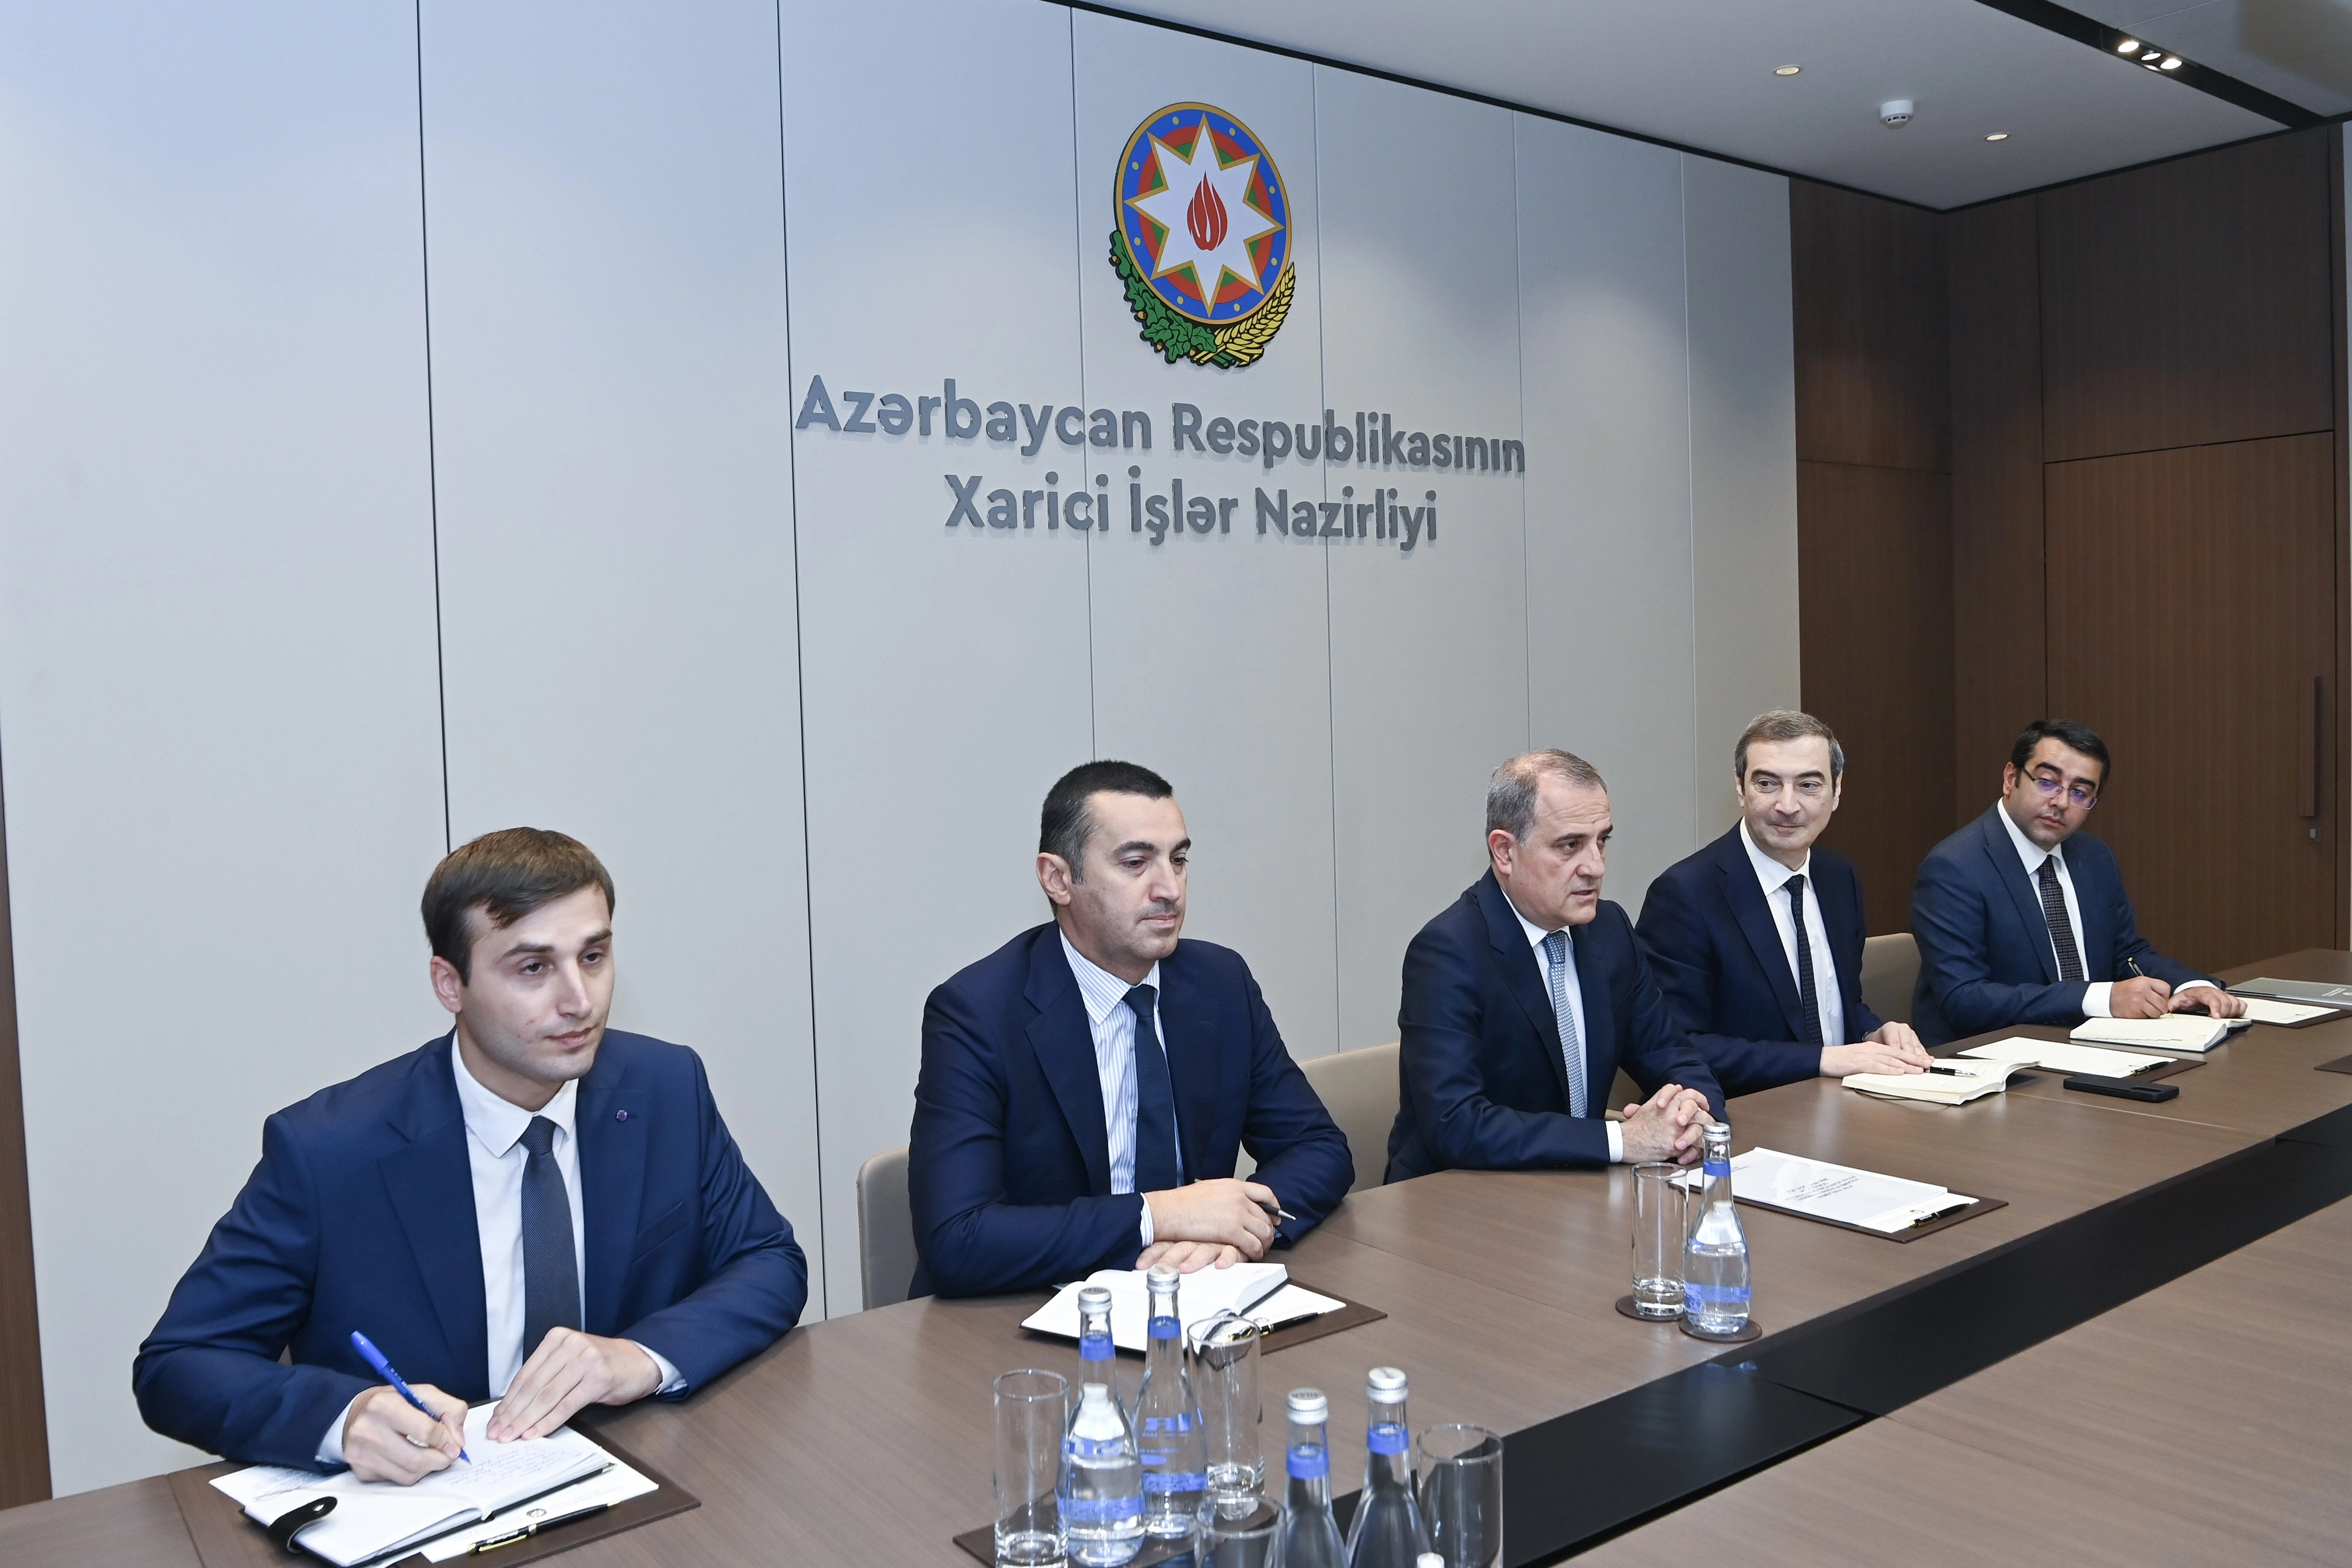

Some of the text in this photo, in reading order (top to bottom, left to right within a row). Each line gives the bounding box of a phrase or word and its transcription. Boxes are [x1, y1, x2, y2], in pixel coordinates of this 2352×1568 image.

[795, 375, 1525, 472] Azərbaycan Respublikasının
[944, 465, 1437, 551] Xarici İşlər Nazirliyi
